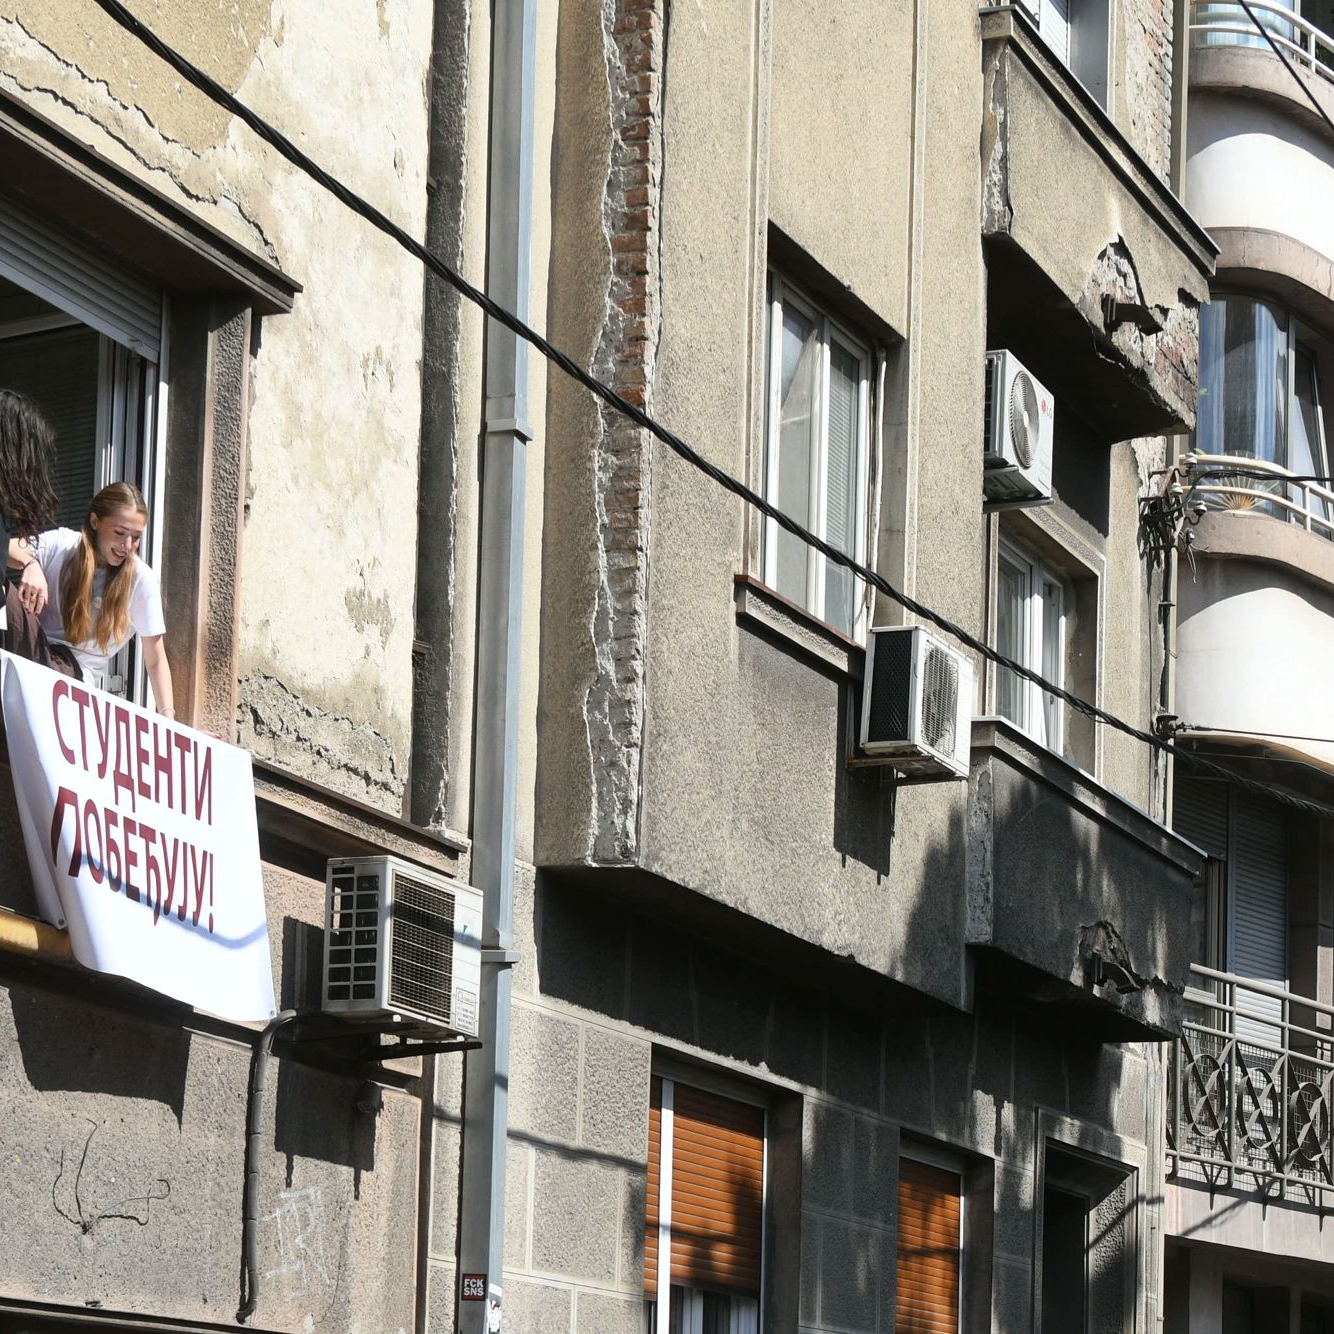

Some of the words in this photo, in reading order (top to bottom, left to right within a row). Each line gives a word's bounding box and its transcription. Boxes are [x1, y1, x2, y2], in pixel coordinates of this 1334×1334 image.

[52, 679, 212, 827] СТУДЕНТИ
[51, 785, 214, 934] ПОБЕЂУЈУ!
[463, 1278, 484, 1288] FCK
[463, 1287, 484, 1296] SNS
